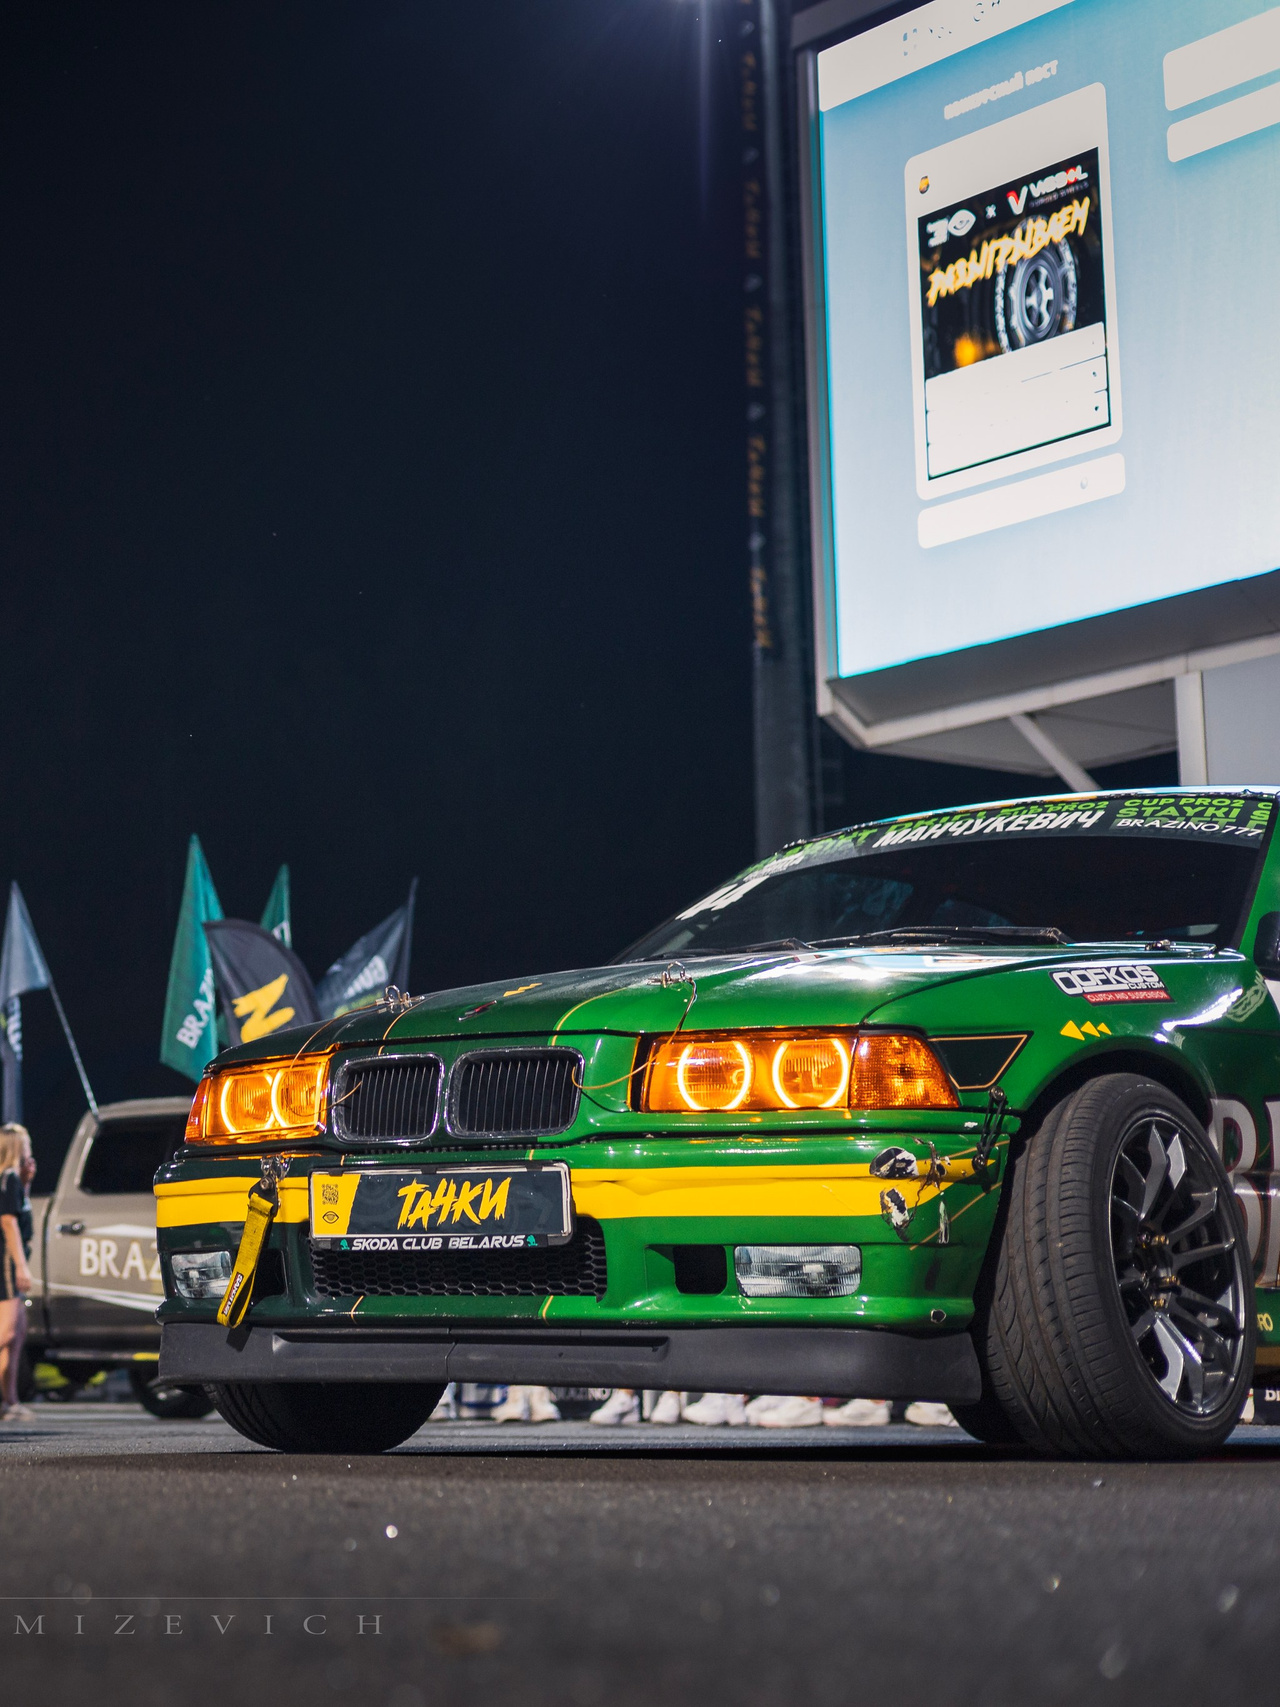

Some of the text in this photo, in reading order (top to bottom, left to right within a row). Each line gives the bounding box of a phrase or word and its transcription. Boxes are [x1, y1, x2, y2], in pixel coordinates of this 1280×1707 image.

[871, 810, 1105, 849] МАНЧУКЕВИЧ
[1128, 980, 1165, 989] CUSTOM
[397, 1177, 512, 1231] ТАЧКИ
[352, 1234, 526, 1251] SKODA CLUB BELARUS
